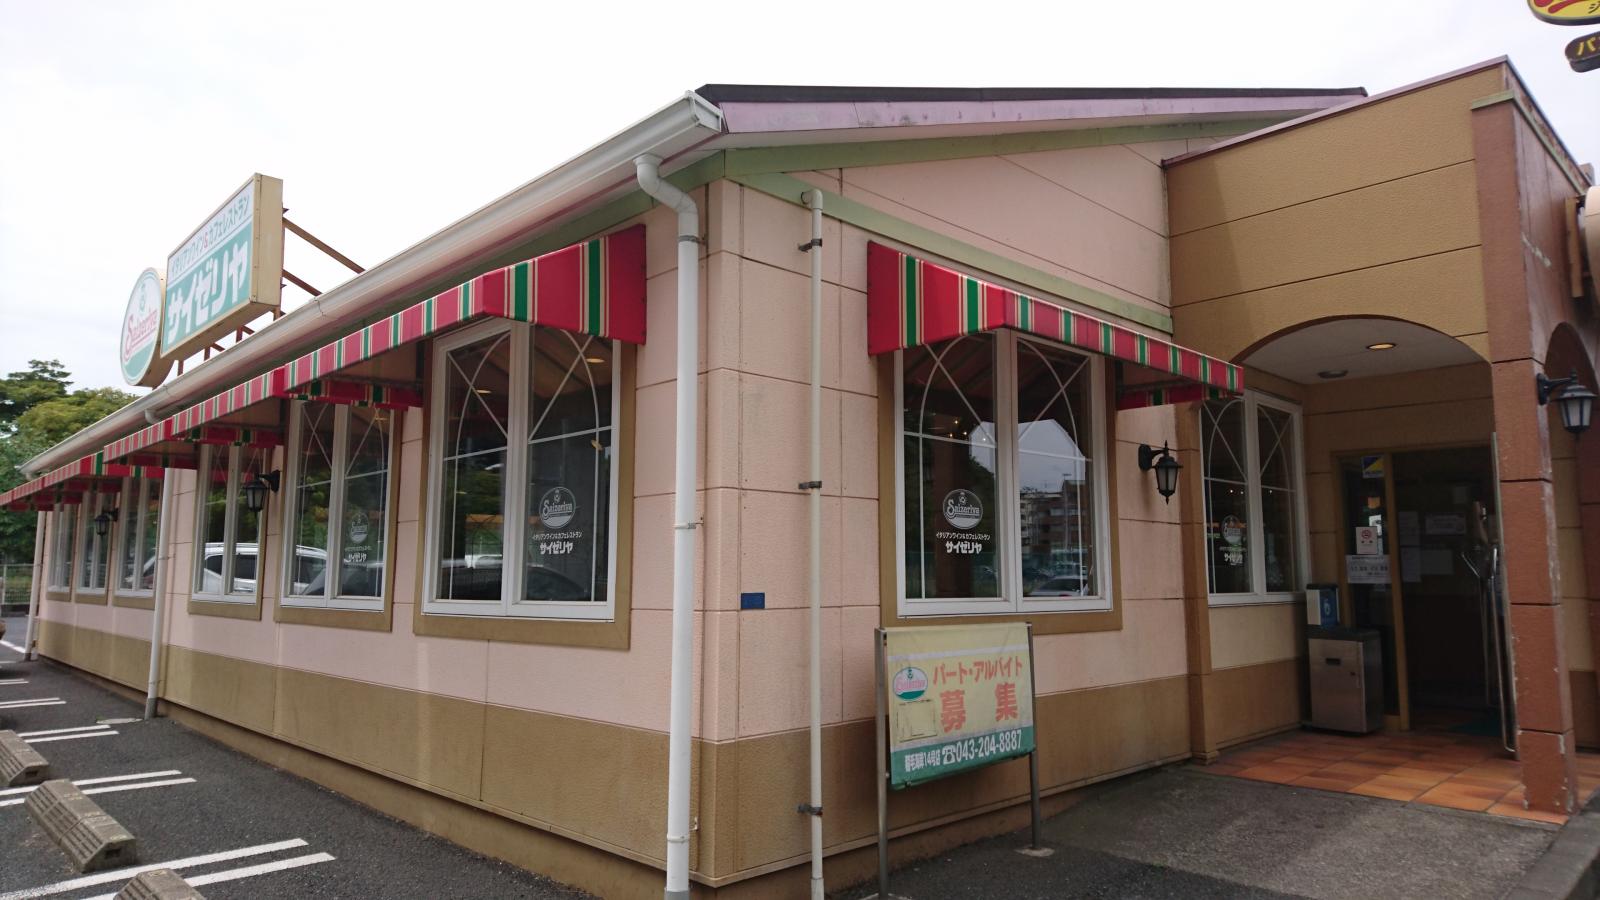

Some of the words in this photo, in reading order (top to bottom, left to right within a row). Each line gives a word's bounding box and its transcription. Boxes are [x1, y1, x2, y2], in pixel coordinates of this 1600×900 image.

[1577, 36, 1600, 56] パ
[168, 241, 248, 345] サイゼリヤ
[540, 541, 574, 555] サイゼリヤ
[945, 541, 983, 555] サイゼリヤ
[932, 655, 1023, 686] パート・アルバイト
[939, 688, 967, 733] 募
[994, 682, 1019, 722] 集
[956, 729, 1022, 763] 043-204-8887
